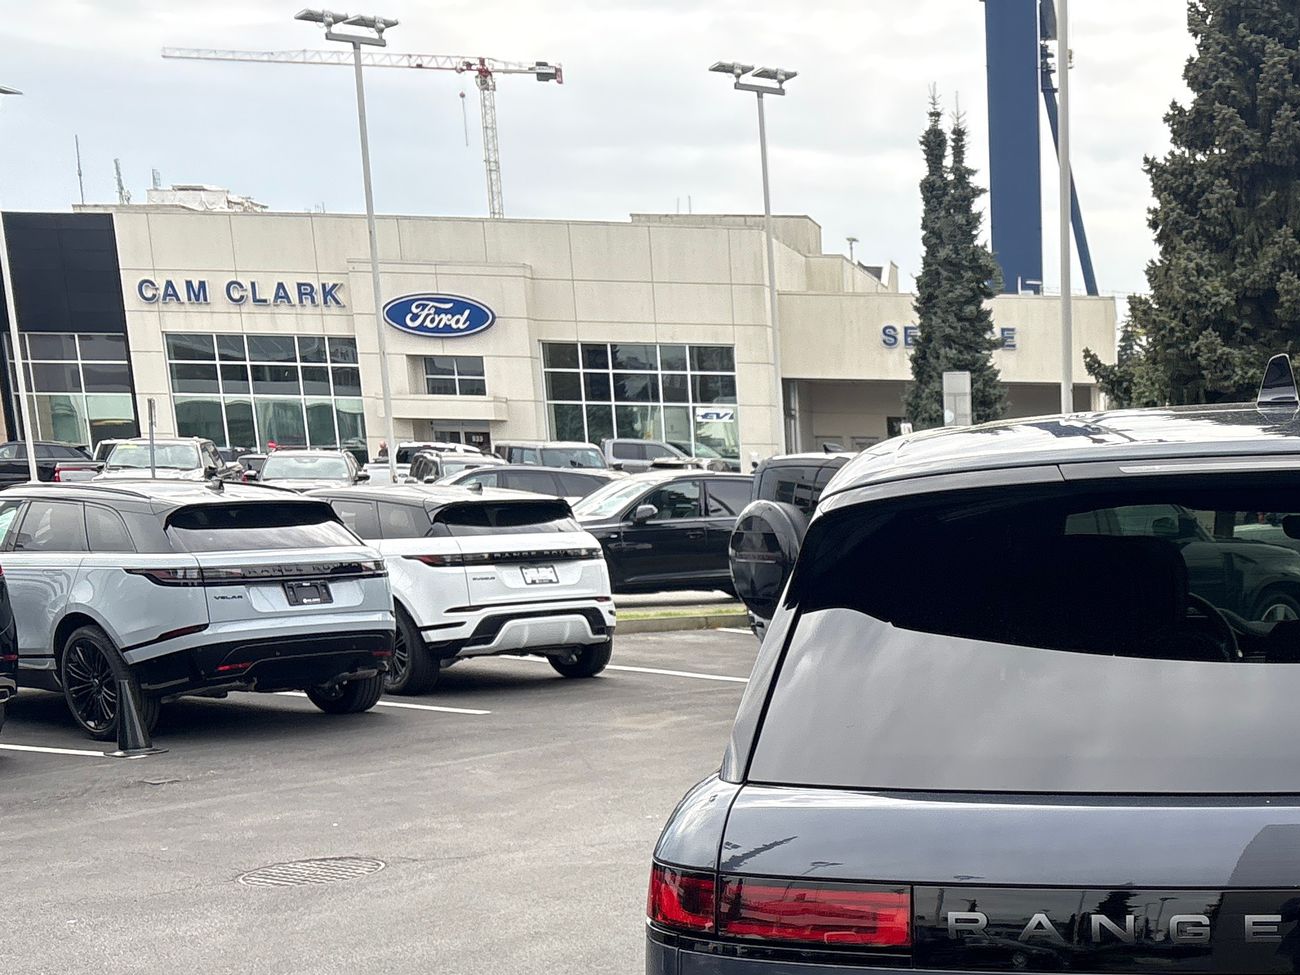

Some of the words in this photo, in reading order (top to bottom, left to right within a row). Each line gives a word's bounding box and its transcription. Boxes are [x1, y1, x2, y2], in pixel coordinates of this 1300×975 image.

[137, 278, 211, 305] CAM
[225, 280, 345, 308] CLARK
[405, 301, 470, 331] Ford
[947, 911, 1284, 944] RANGE
